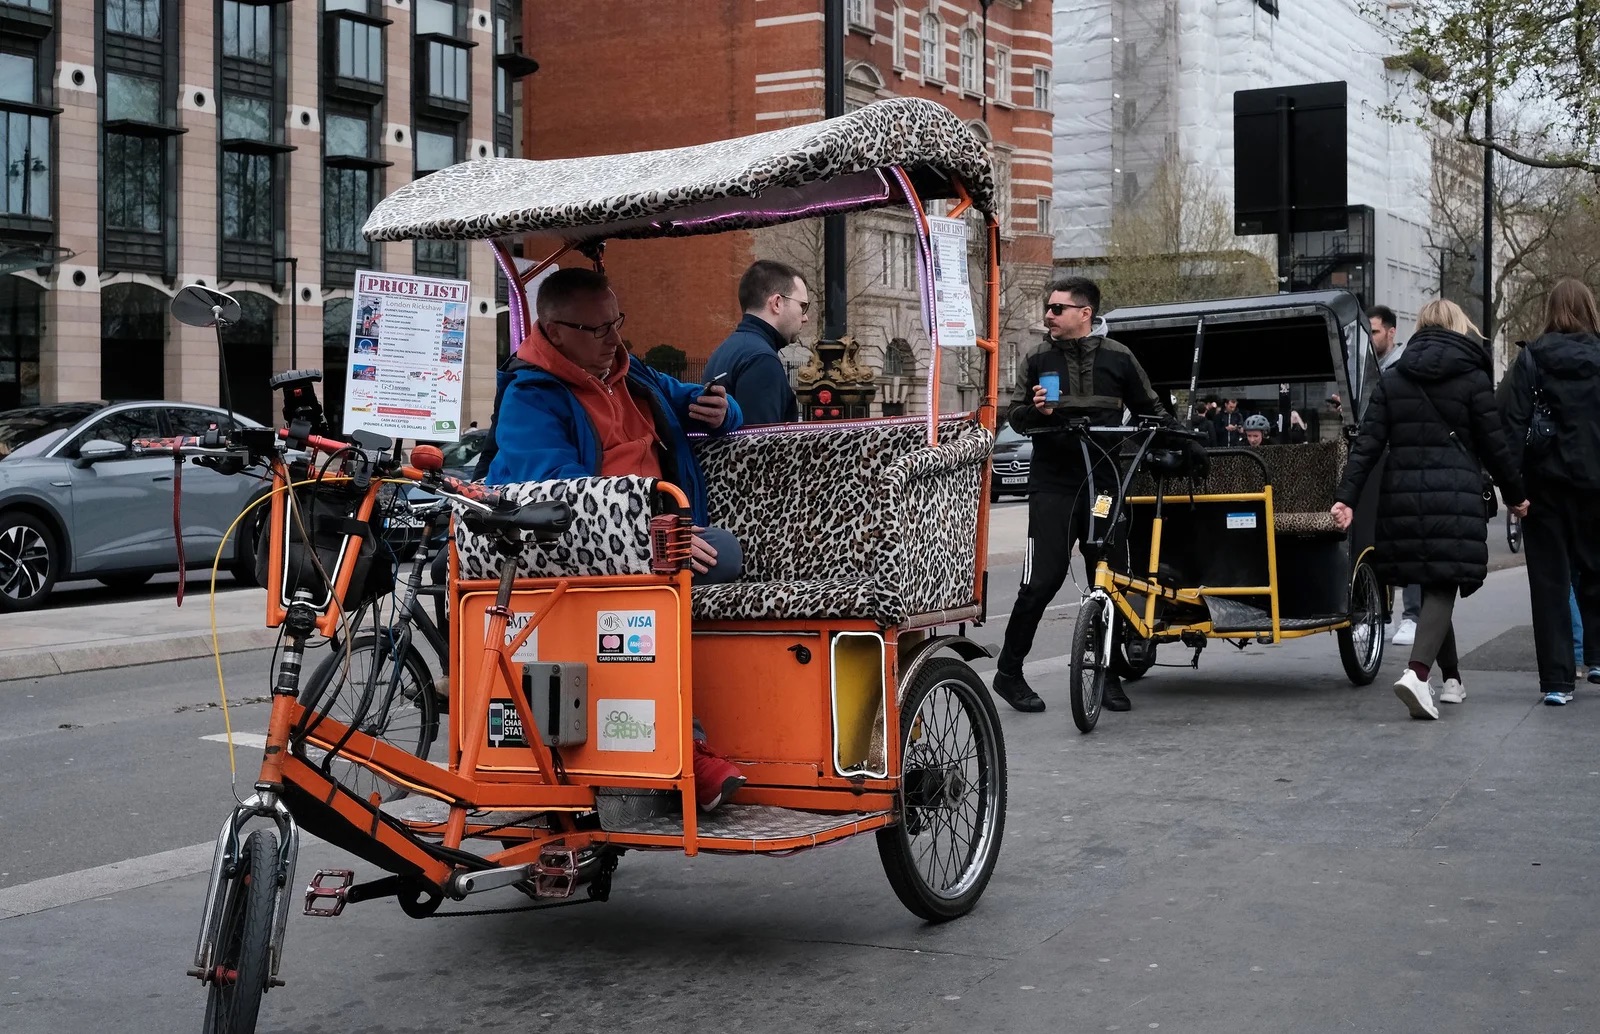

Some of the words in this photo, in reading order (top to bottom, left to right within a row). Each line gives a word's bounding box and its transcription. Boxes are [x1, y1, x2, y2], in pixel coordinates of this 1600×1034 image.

[933, 221, 950, 233] PRICE
[952, 224, 963, 235] LIST
[367, 278, 418, 295] PRICE
[424, 283, 459, 298] LIST
[386, 300, 411, 309] London
[412, 302, 442, 311] Rickshaw
[627, 616, 652, 628] VISA
[610, 710, 629, 723] GO
[504, 719, 522, 727] CHAR
[504, 727, 523, 736] STAT
